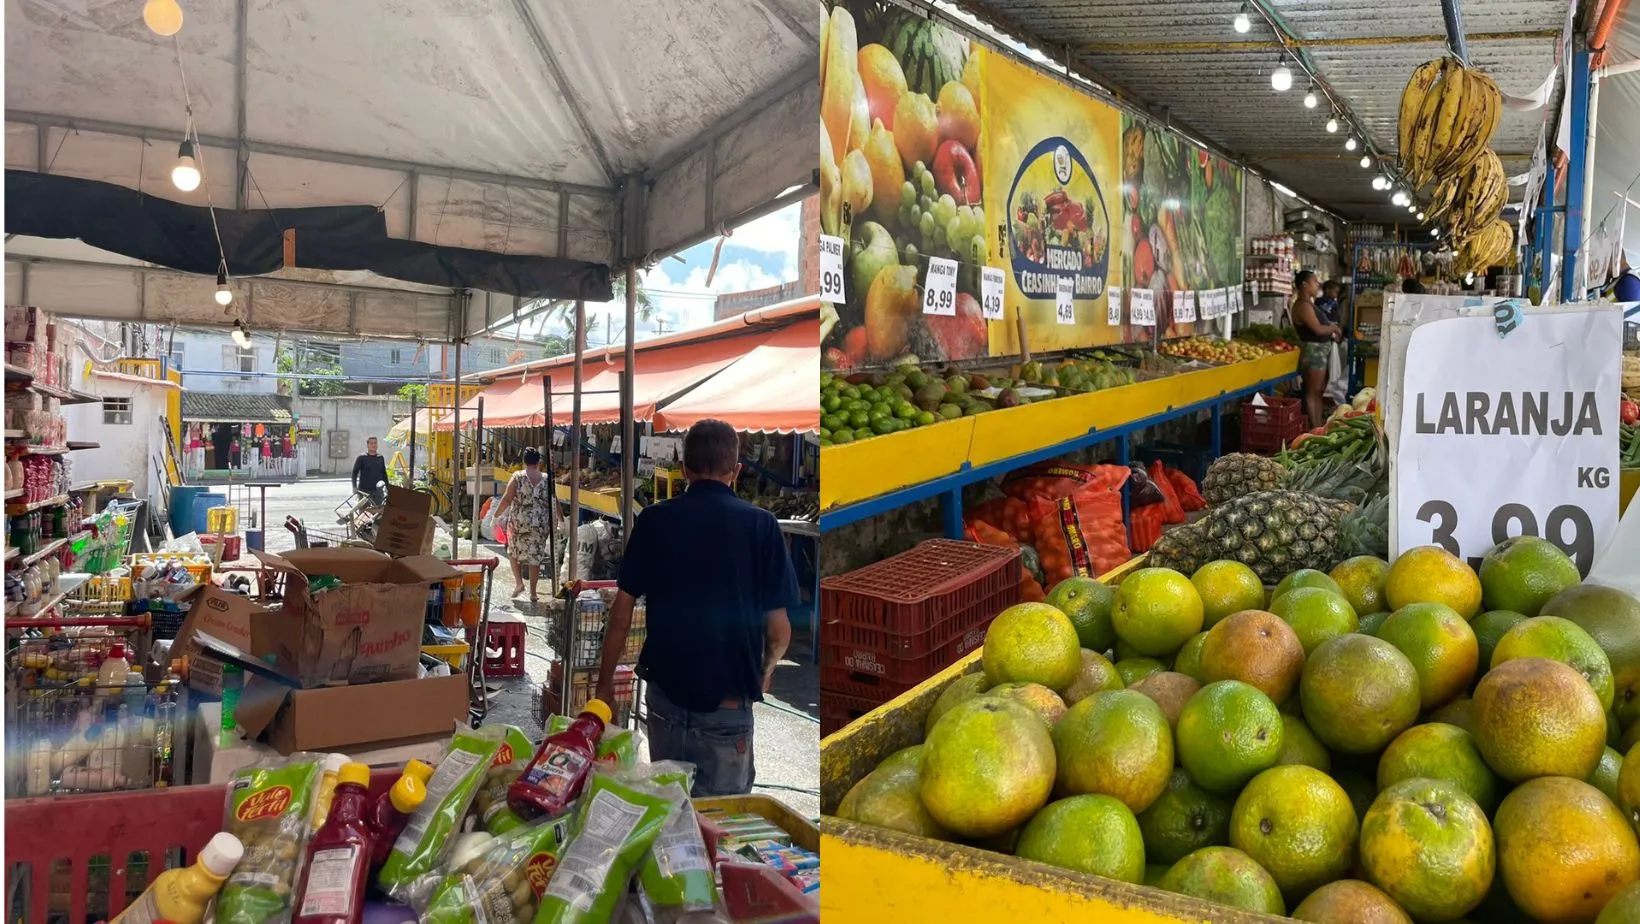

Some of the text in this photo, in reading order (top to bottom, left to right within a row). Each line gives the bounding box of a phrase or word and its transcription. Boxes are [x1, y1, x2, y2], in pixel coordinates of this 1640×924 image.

[930, 263, 946, 276] MANGA
[1046, 247, 1082, 271] MERCADO
[1021, 270, 1059, 293] CEASINH
[1075, 274, 1103, 294] BAIRRO
[926, 288, 953, 312] 8,99
[1415, 391, 1603, 436] LARANJA
[1577, 466, 1611, 489] KG
